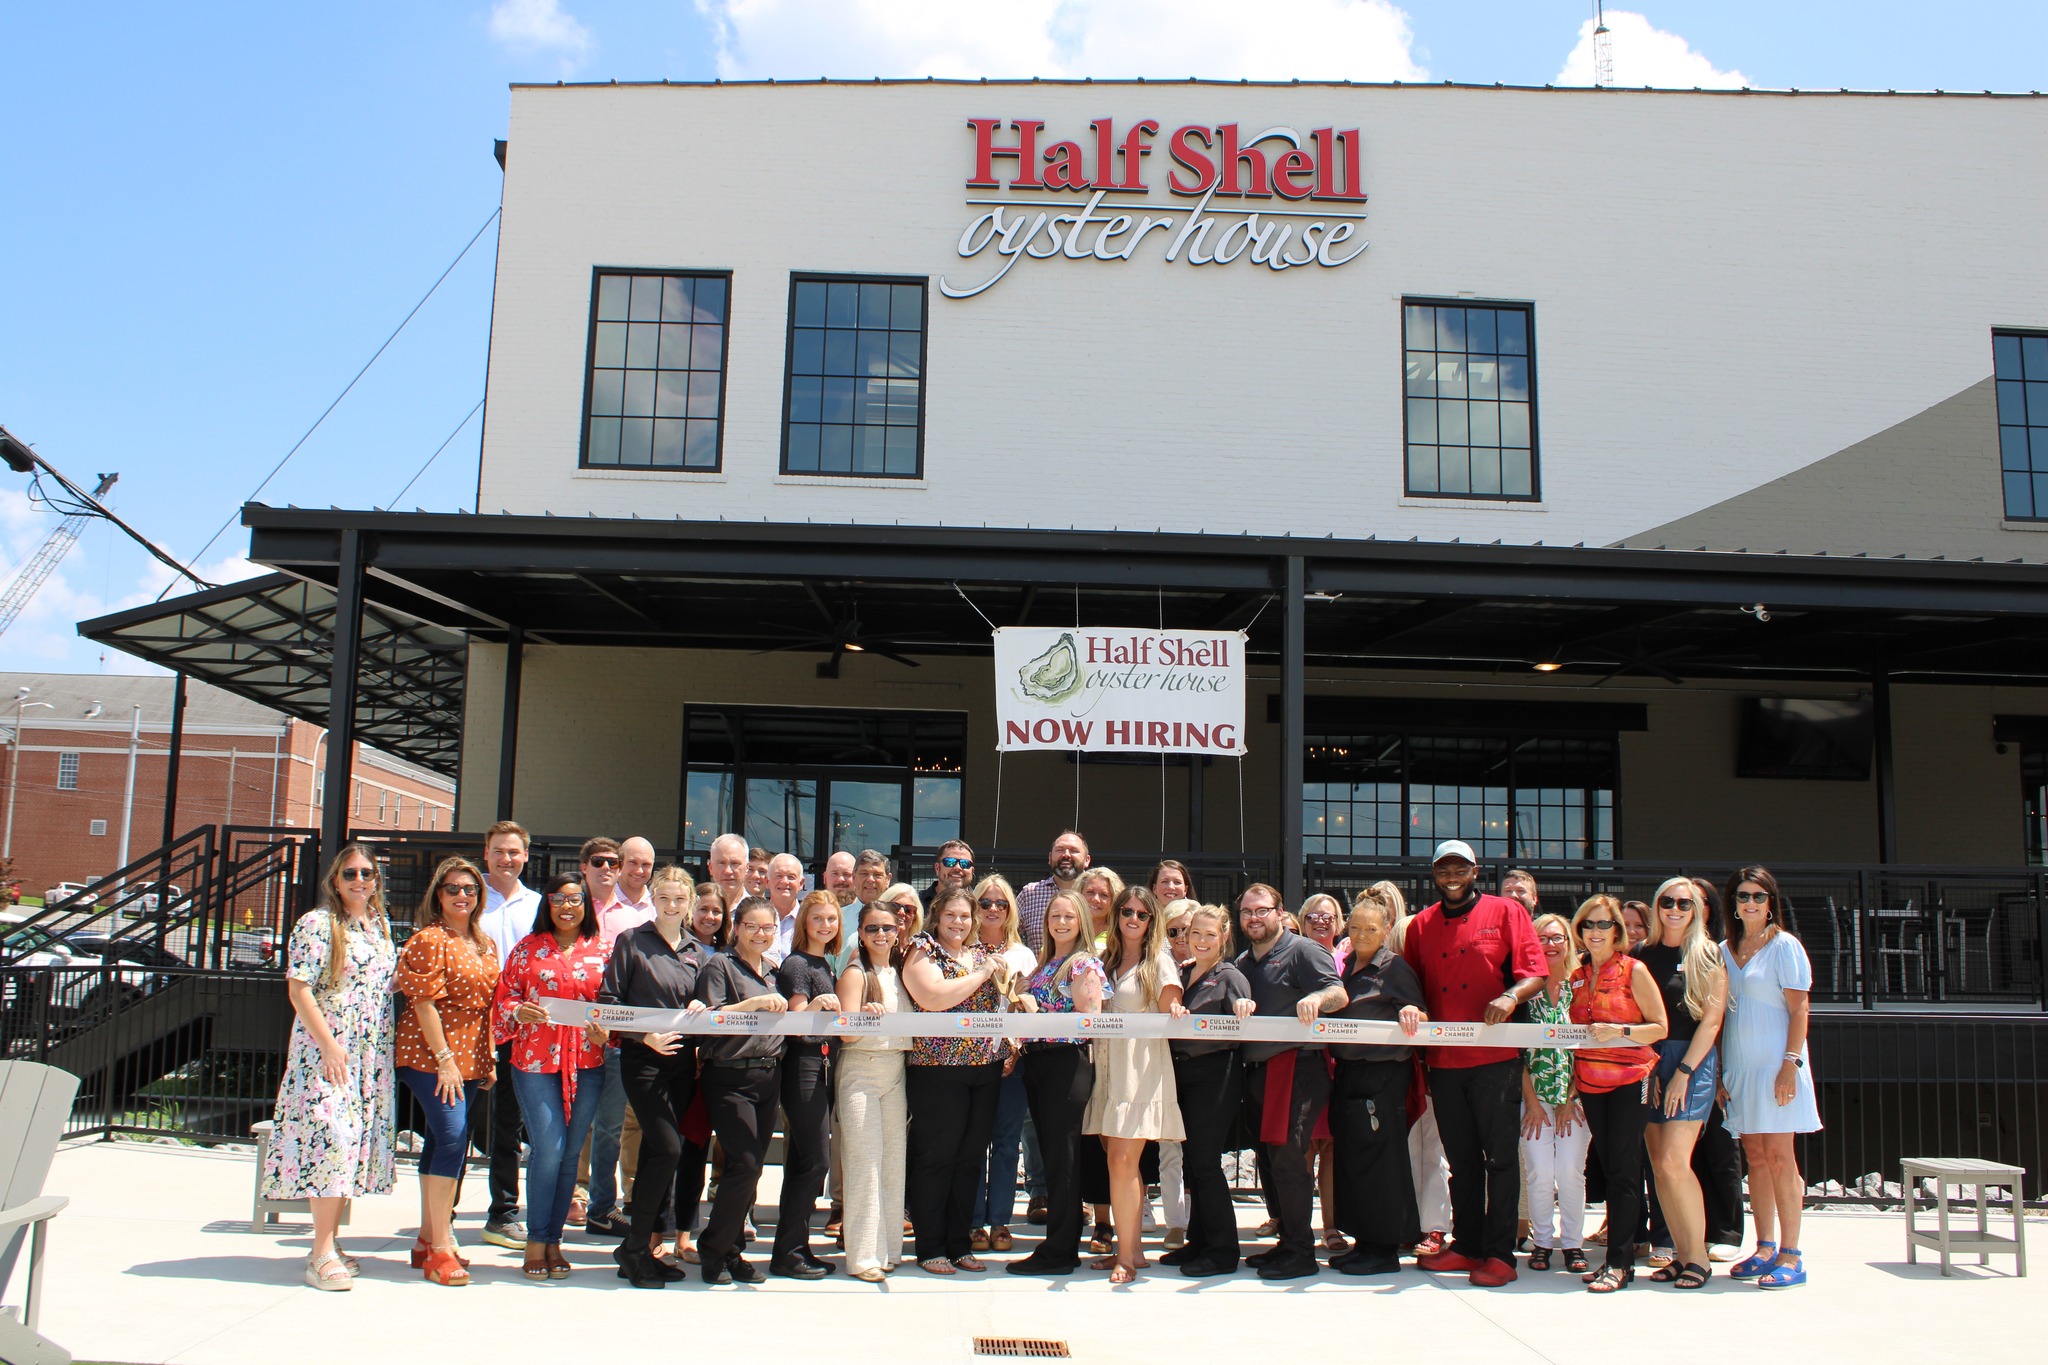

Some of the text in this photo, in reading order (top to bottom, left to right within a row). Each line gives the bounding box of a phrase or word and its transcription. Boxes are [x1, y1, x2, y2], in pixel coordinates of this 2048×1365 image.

[966, 116, 1369, 202] Half Shell
[939, 173, 1369, 298] oyster house
[1085, 636, 1230, 668] Half Shell
[1071, 659, 1231, 717] oyster house
[1006, 718, 1236, 749] NOW HIRING
[602, 1008, 635, 1016] CULLMAN
